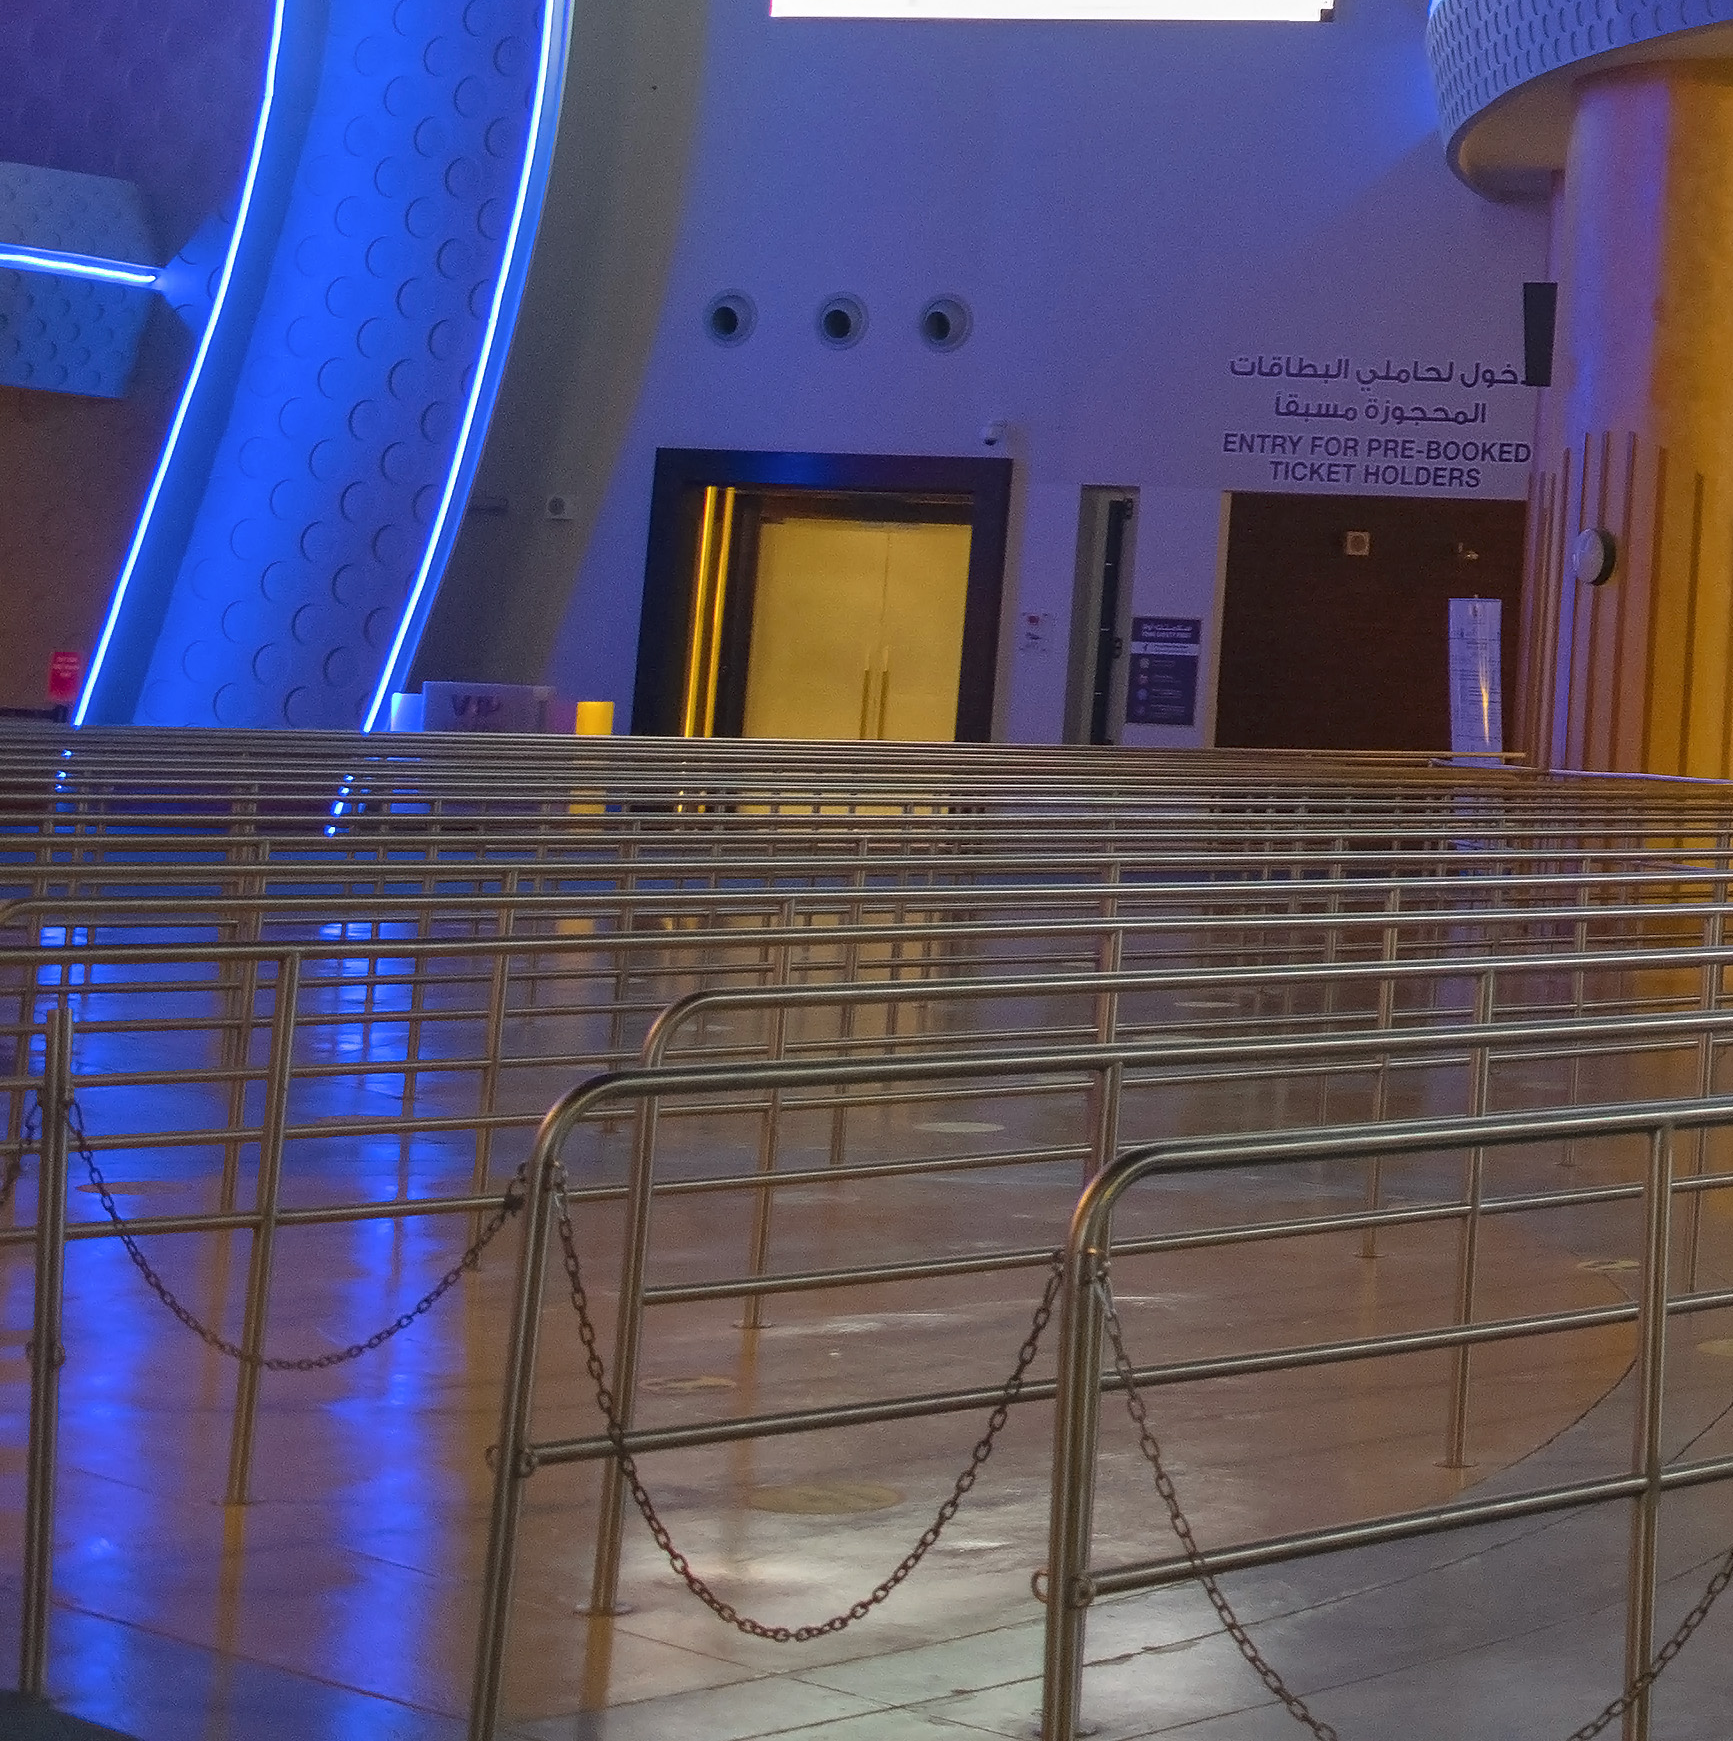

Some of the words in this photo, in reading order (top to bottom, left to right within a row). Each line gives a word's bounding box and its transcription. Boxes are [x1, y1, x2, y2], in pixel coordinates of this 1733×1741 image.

[1230, 355, 1350, 384] البطاقات
[1356, 360, 1454, 392] لحاملي
[1364, 397, 1487, 426] المحجوزة
[1223, 432, 1304, 453] ENTRY
[1310, 436, 1359, 457] FOR
[1367, 438, 1531, 463] PRE-BOOKED
[1269, 460, 1357, 484] TICKET
[1364, 464, 1481, 488] HOLDERS
